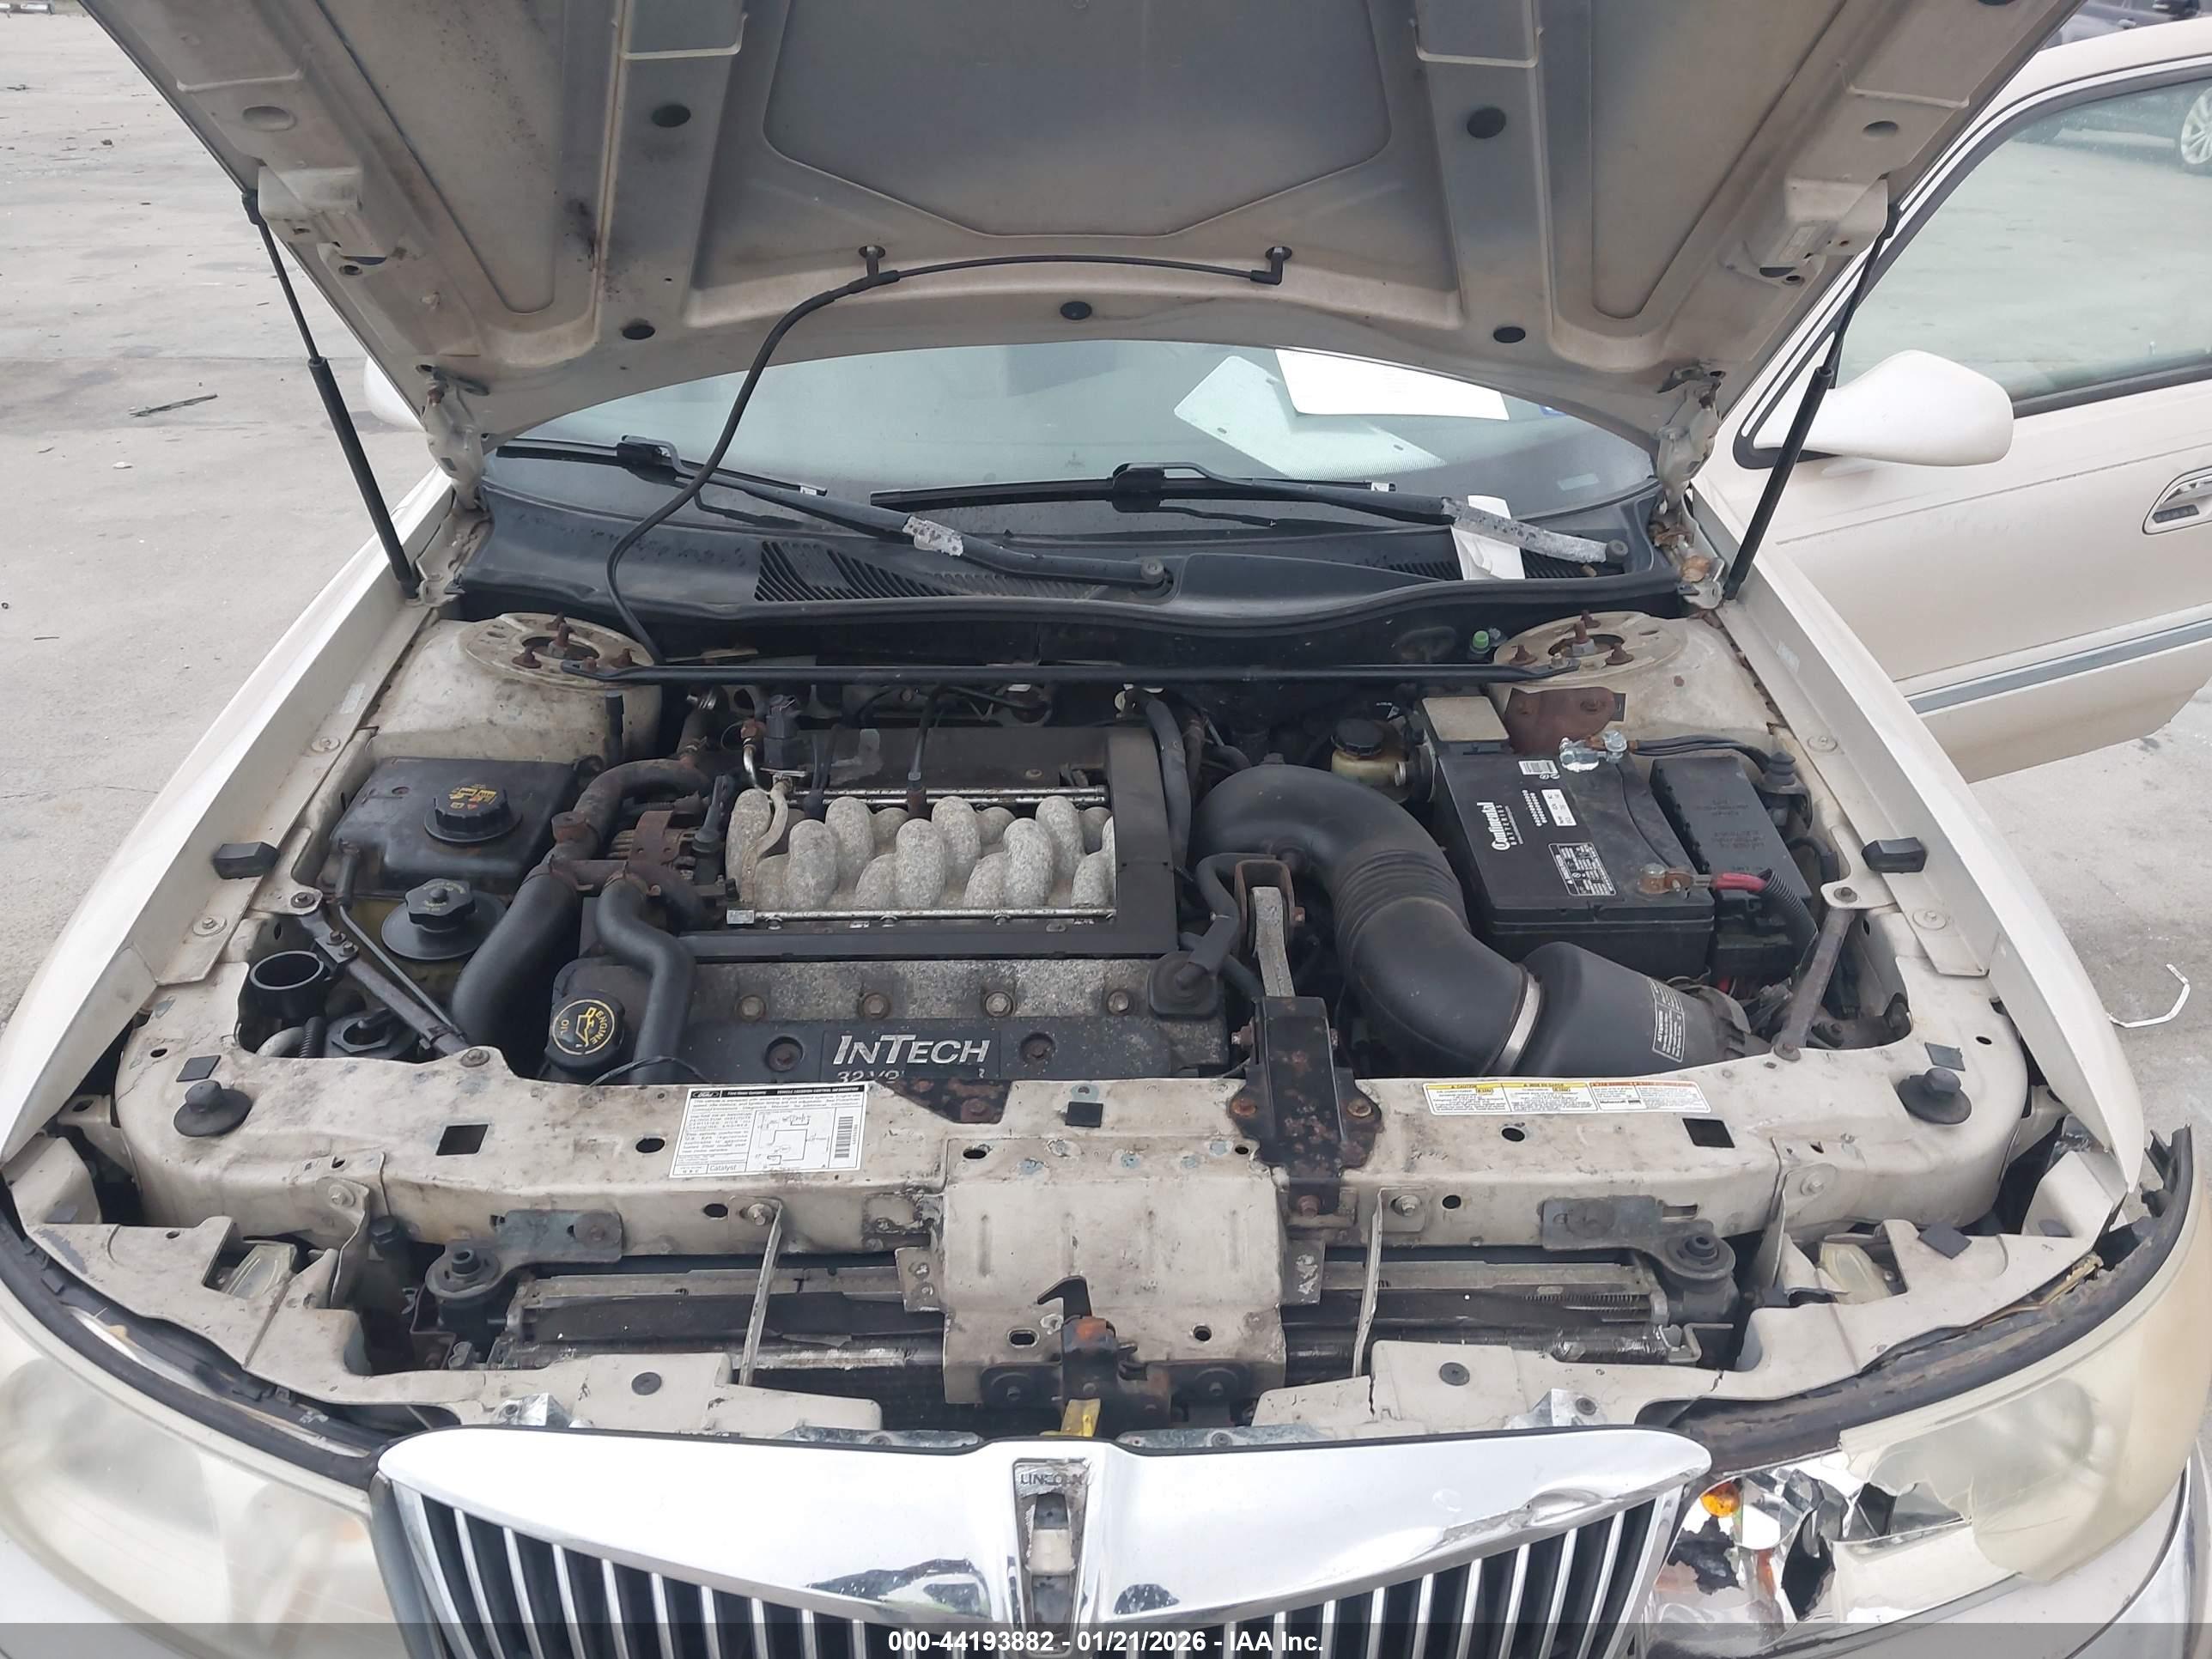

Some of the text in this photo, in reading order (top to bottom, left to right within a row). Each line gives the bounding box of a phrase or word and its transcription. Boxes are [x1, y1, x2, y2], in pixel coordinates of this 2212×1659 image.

[1476, 801, 1511, 852] Continental
[1497, 803, 1517, 846] BATTERIES
[560, 1019, 570, 1036] OIL
[590, 1011, 608, 1045] ENGINE
